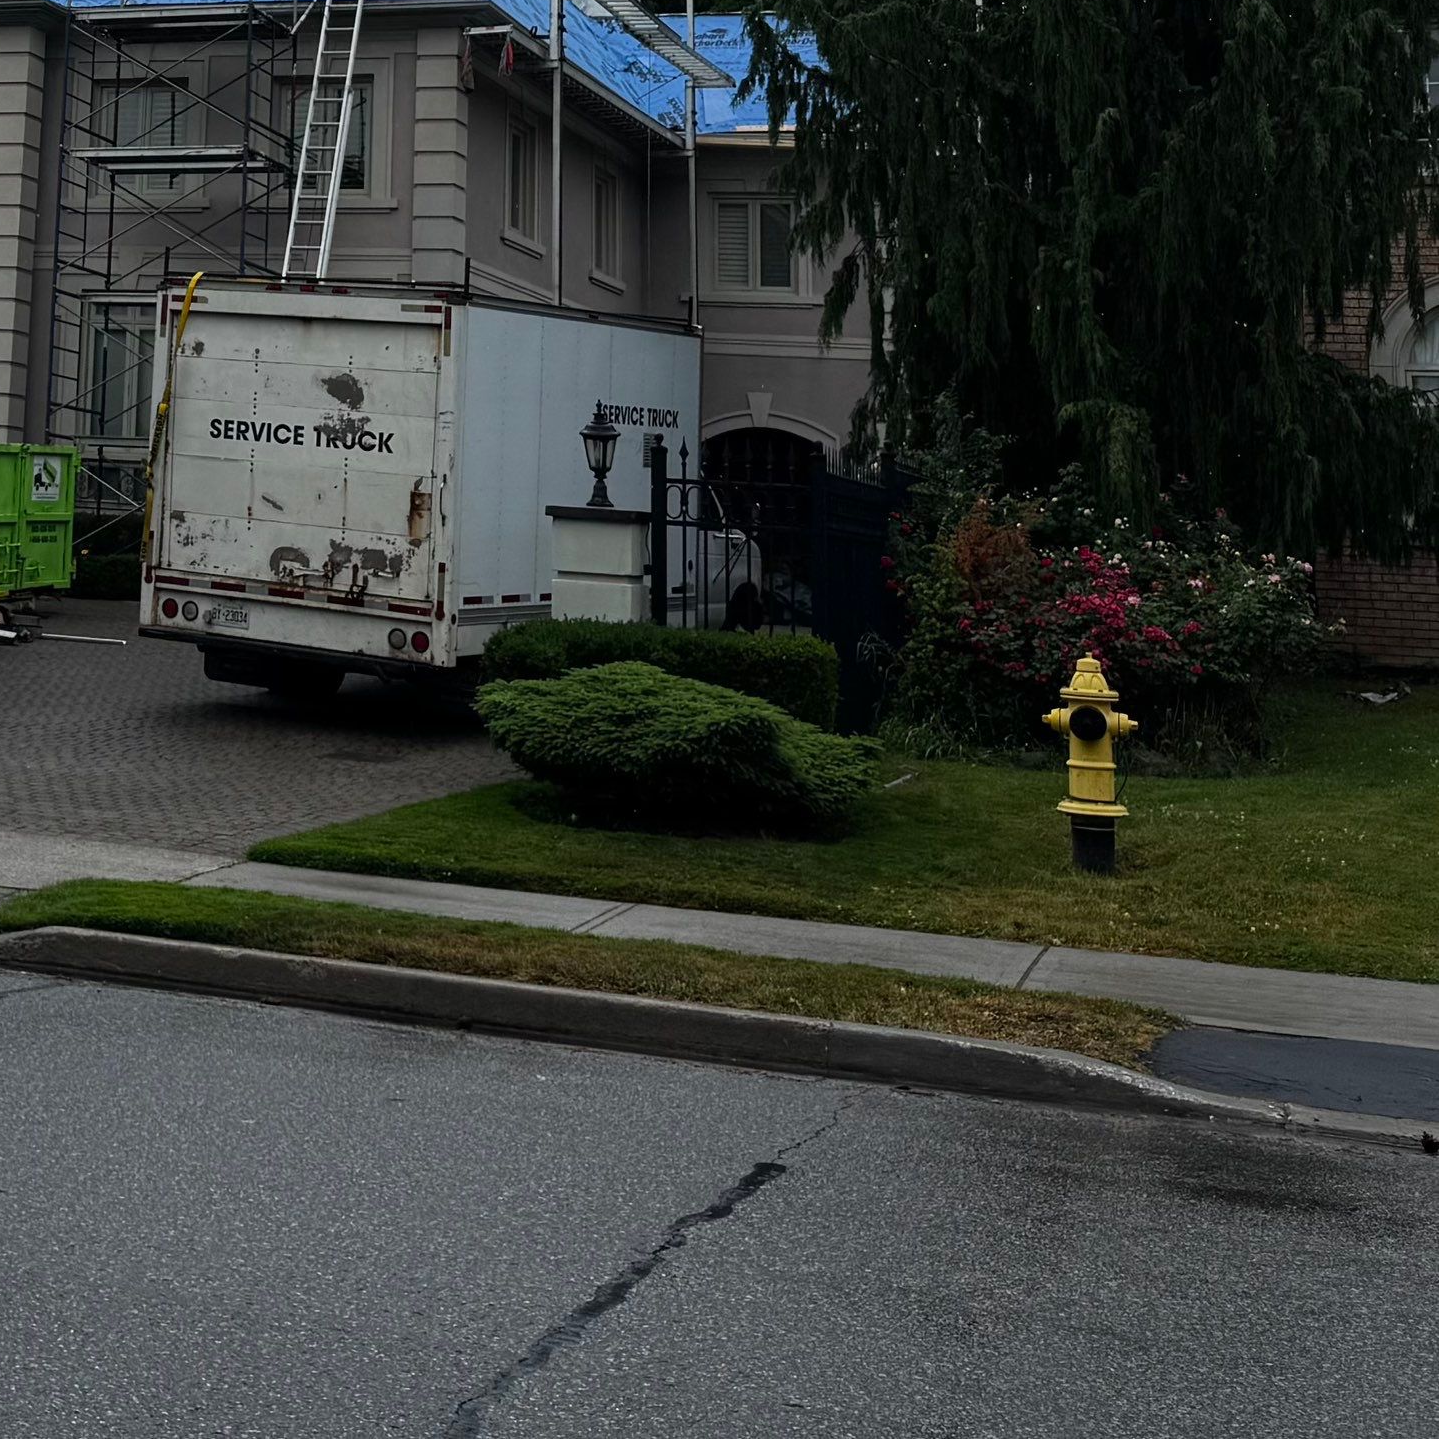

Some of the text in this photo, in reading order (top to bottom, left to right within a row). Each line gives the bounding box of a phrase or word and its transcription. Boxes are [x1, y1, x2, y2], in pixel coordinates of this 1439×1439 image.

[602, 404, 679, 429] SERVICE TRUCK
[210, 418, 394, 454] SERVICE TRUCK
